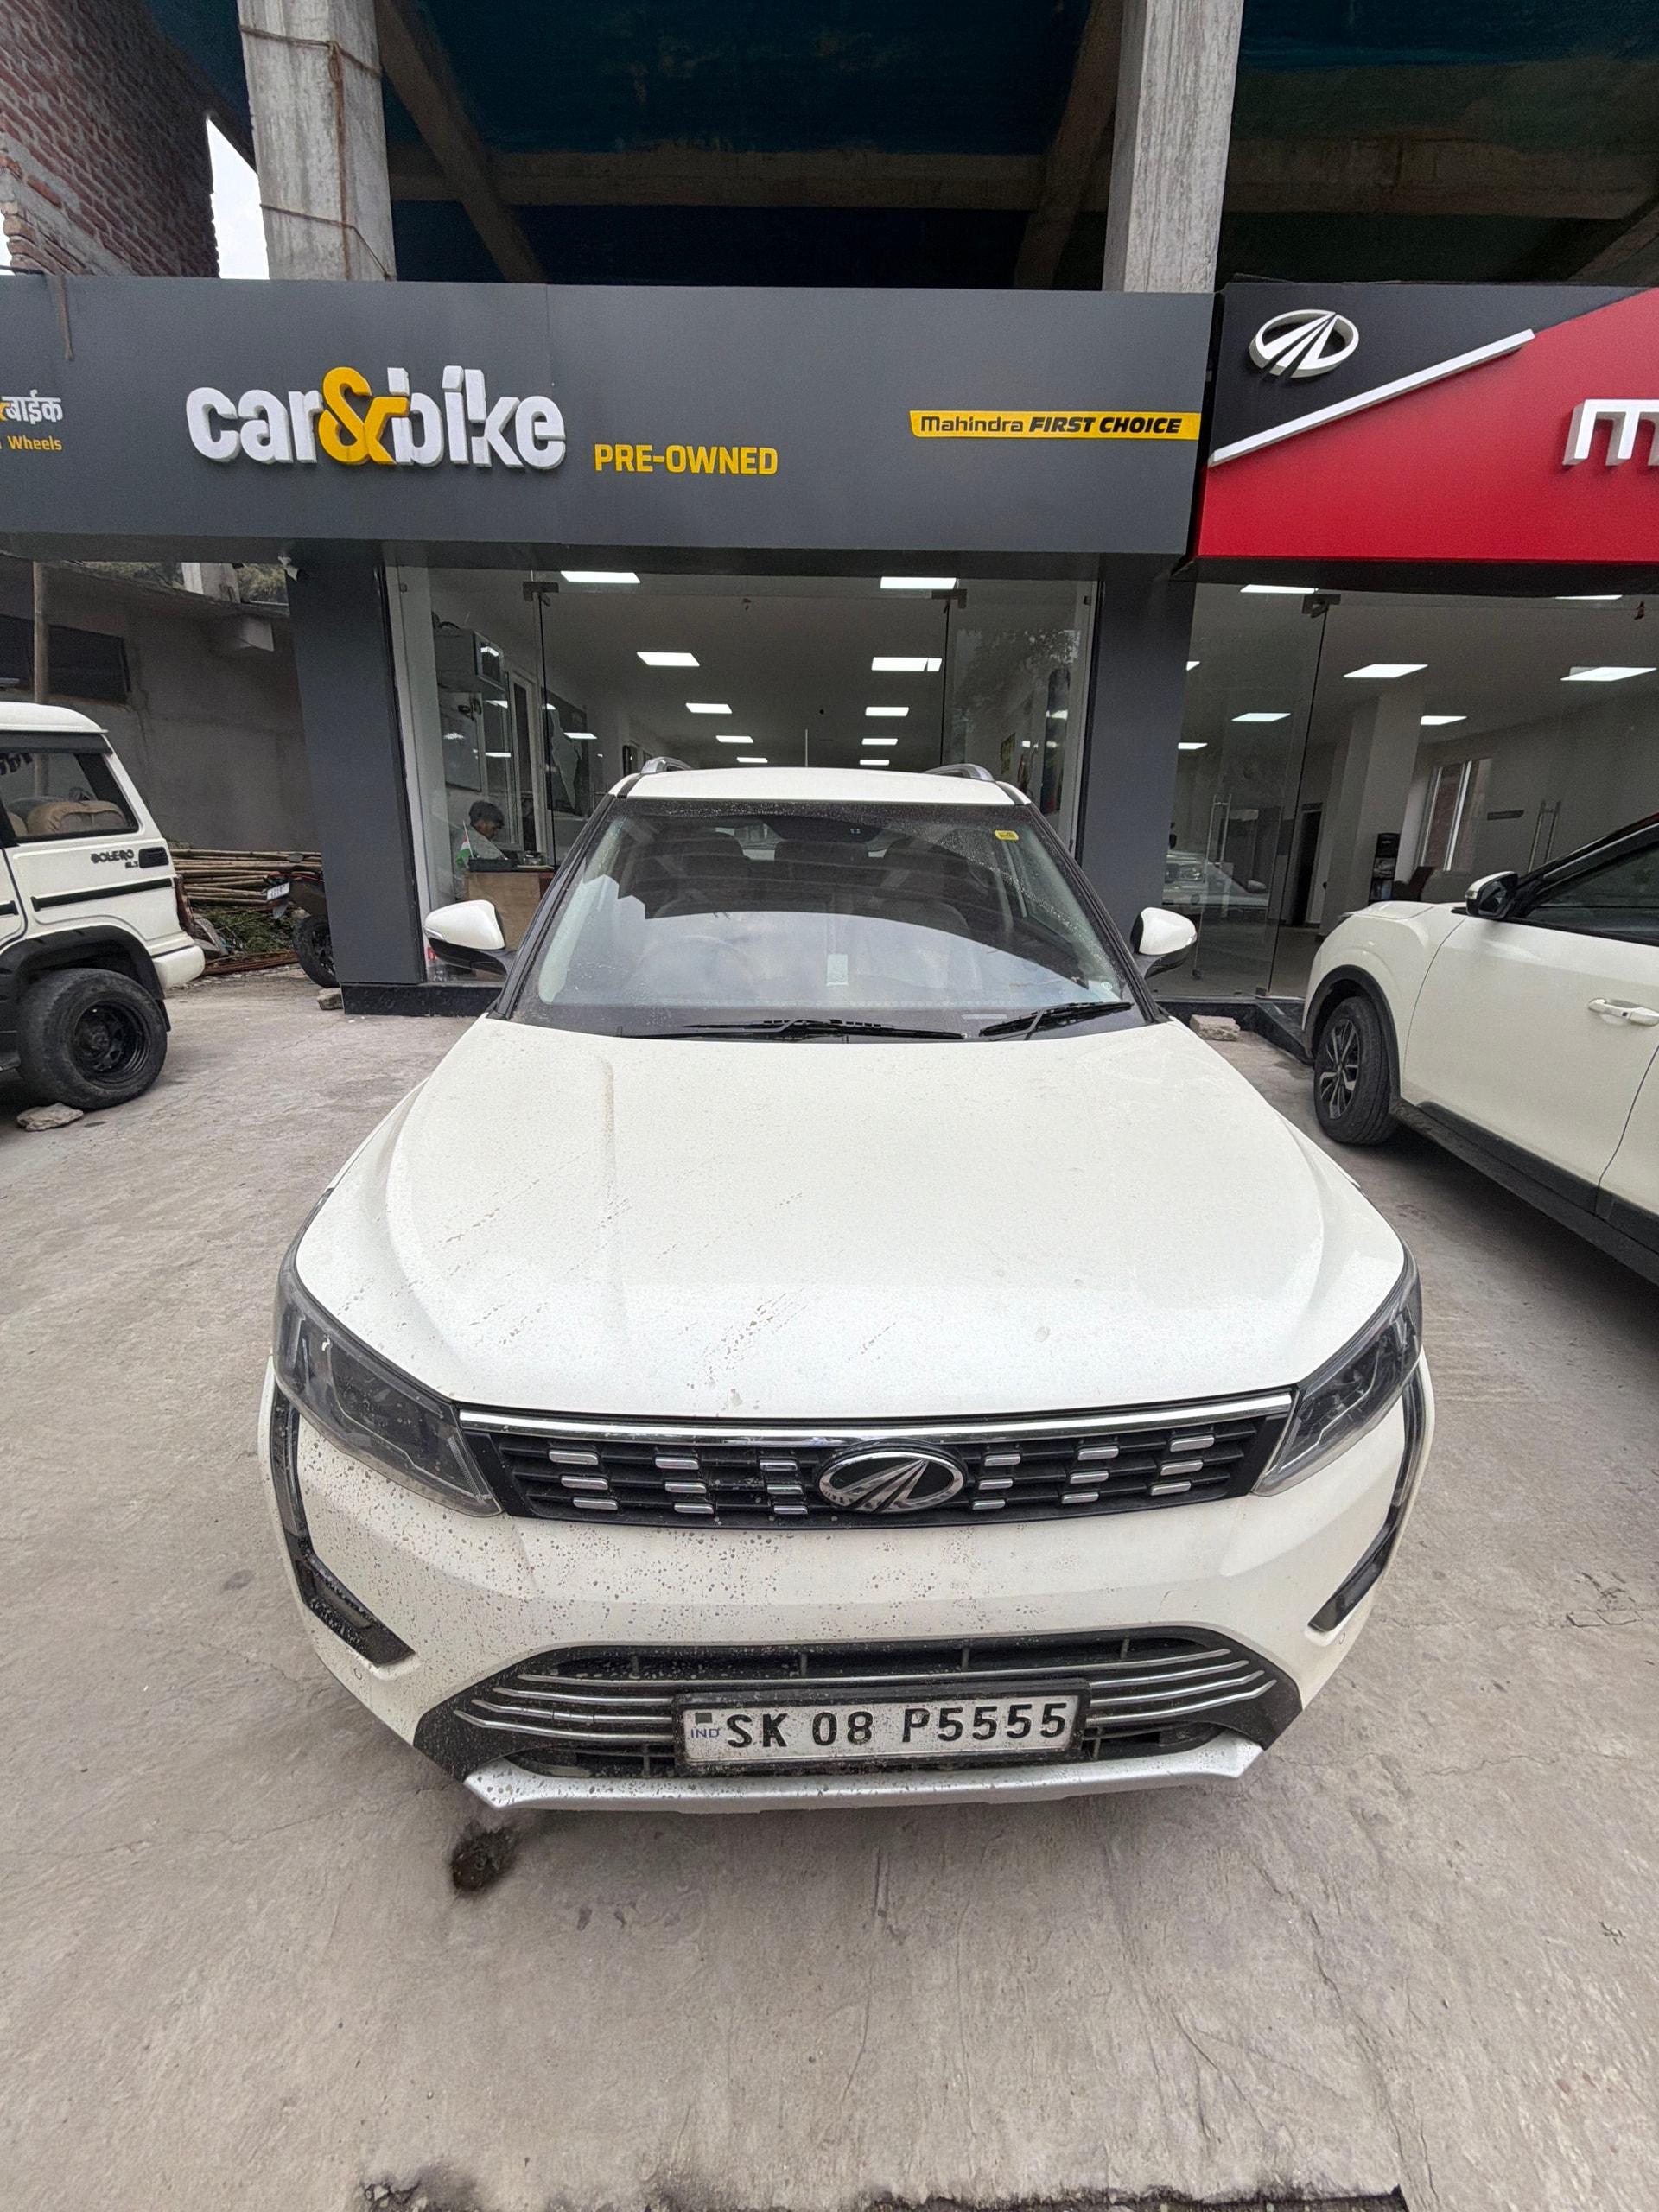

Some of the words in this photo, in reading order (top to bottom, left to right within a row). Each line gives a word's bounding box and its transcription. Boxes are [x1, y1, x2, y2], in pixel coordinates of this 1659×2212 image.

[186, 365, 566, 469] car&bike
[920, 416, 1023, 433] Mahindra
[1028, 416, 1096, 434] FIRST
[1098, 417, 1183, 434] CHOICE
[7, 435, 62, 451] Wheels
[594, 444, 778, 474] PRE-OWNED
[691, 1728, 720, 1738] IND
[727, 1713, 788, 1748] SK
[812, 1712, 873, 1746] 08
[902, 1702, 1068, 1744] P5555
